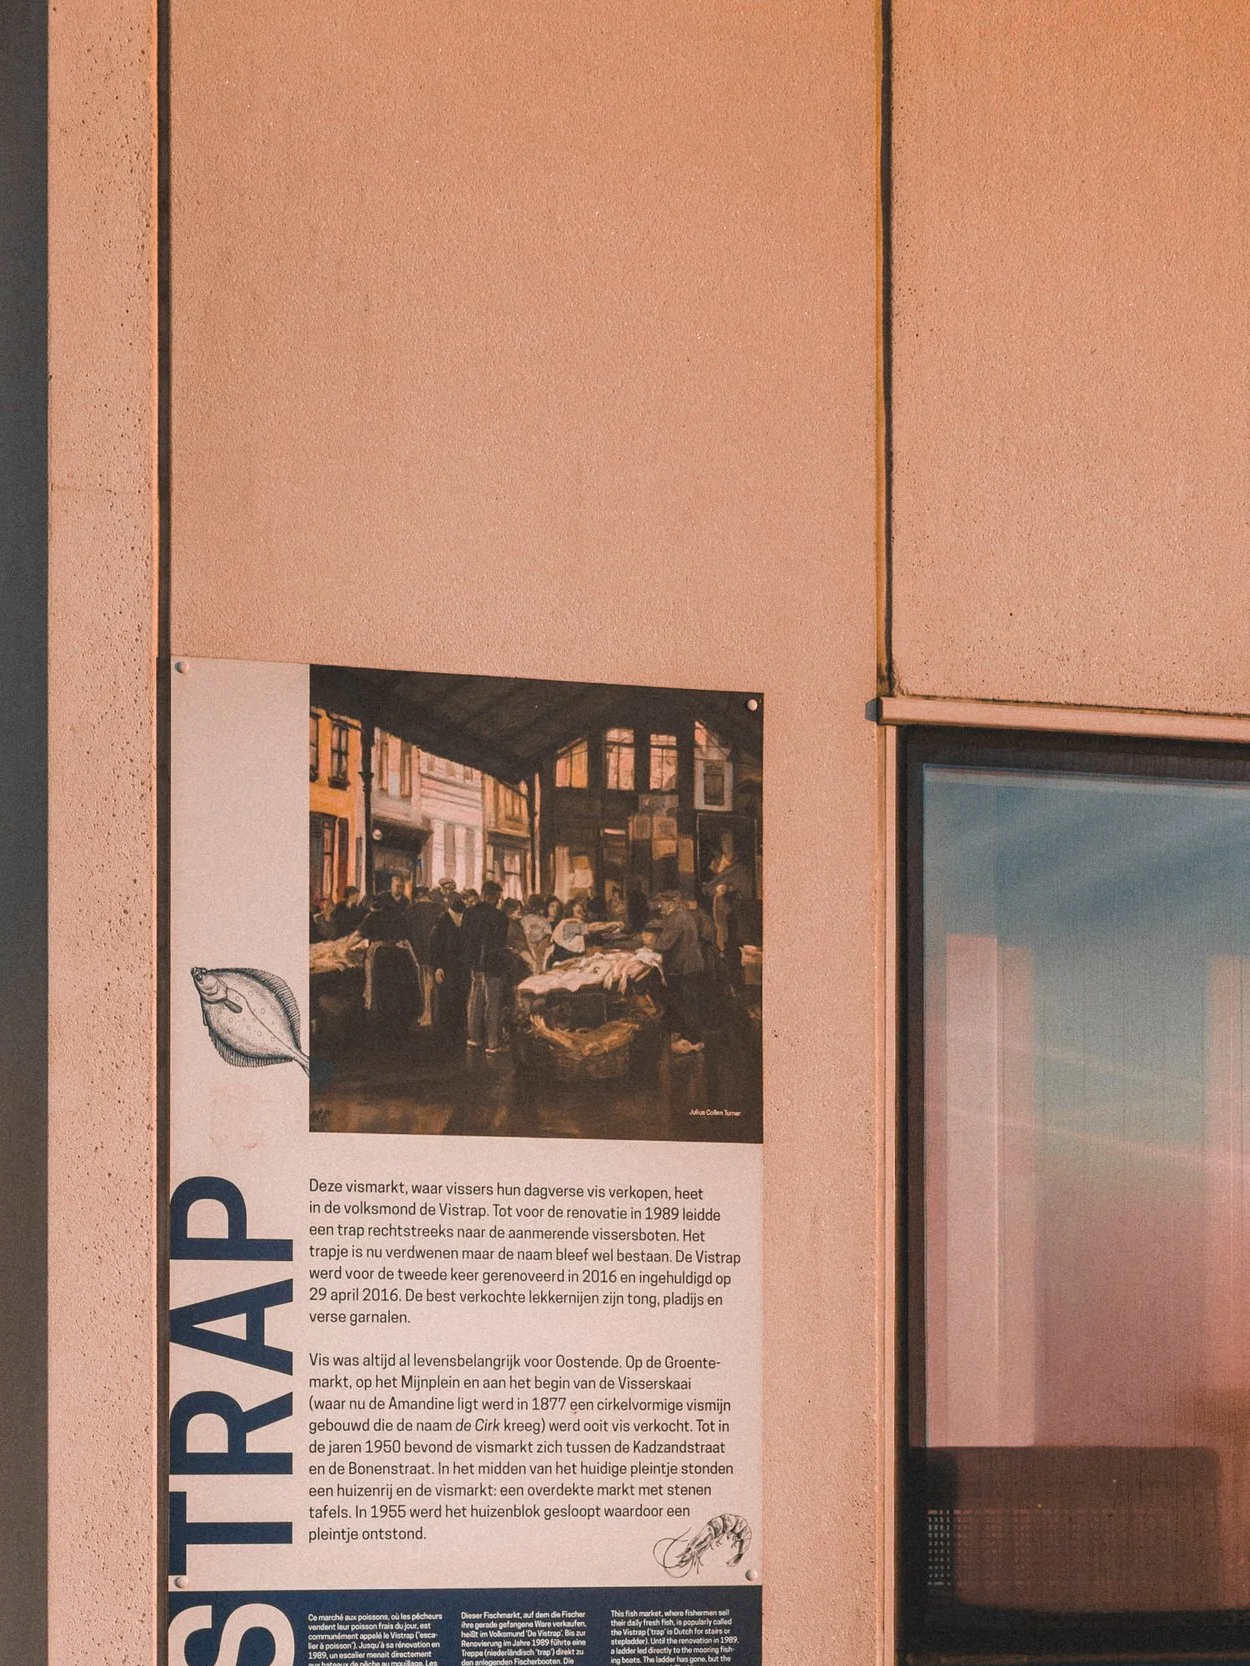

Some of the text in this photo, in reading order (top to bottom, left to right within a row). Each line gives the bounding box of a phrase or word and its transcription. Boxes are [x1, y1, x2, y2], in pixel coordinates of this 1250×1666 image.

[309, 1178, 704, 1202] Deze vismarkt, waar vissers hun dagverse vis verkopen, heet
[309, 1200, 721, 1222] in de volksmond de Vistrap. Tot voor de renovatie in 1989 leidde
[309, 1223, 706, 1243] een trap rechtstreeks naar de aanmerende vissersboten. Het
[309, 1244, 742, 1267] trapje is nu verdwenen maar de naam bleef wel bestaan. De Vistrap
[309, 1265, 732, 1288] werd voor de tweede keer gerenoveerd in 2016 en ingehuldigd op
[309, 1287, 723, 1309] 29 april 2016. De best verkochte lekkernijen zijn tong, pladijs en
[309, 1310, 411, 1327] verse garnalen.
[309, 1352, 721, 1371] Vis was altijd al levensbelangrijk voor Oostende. Op de Groente-
[309, 1374, 691, 1393] markt, op het Mijnplein en aan het begin van de Visserskaai
[309, 1395, 731, 1415] (waar nu de Amandine ligt werd in 1877 een cirkelvormige vismijn
[309, 1418, 730, 1435] gebouwd die de naam de Cirk kreeg) werd ooit vis verkocht. Tot in
[461, 1611, 483, 1619] Dieser
[561, 1610, 586, 1618] Fischer
[625, 1609, 638, 1617] fish
[718, 1608, 730, 1616] sell
